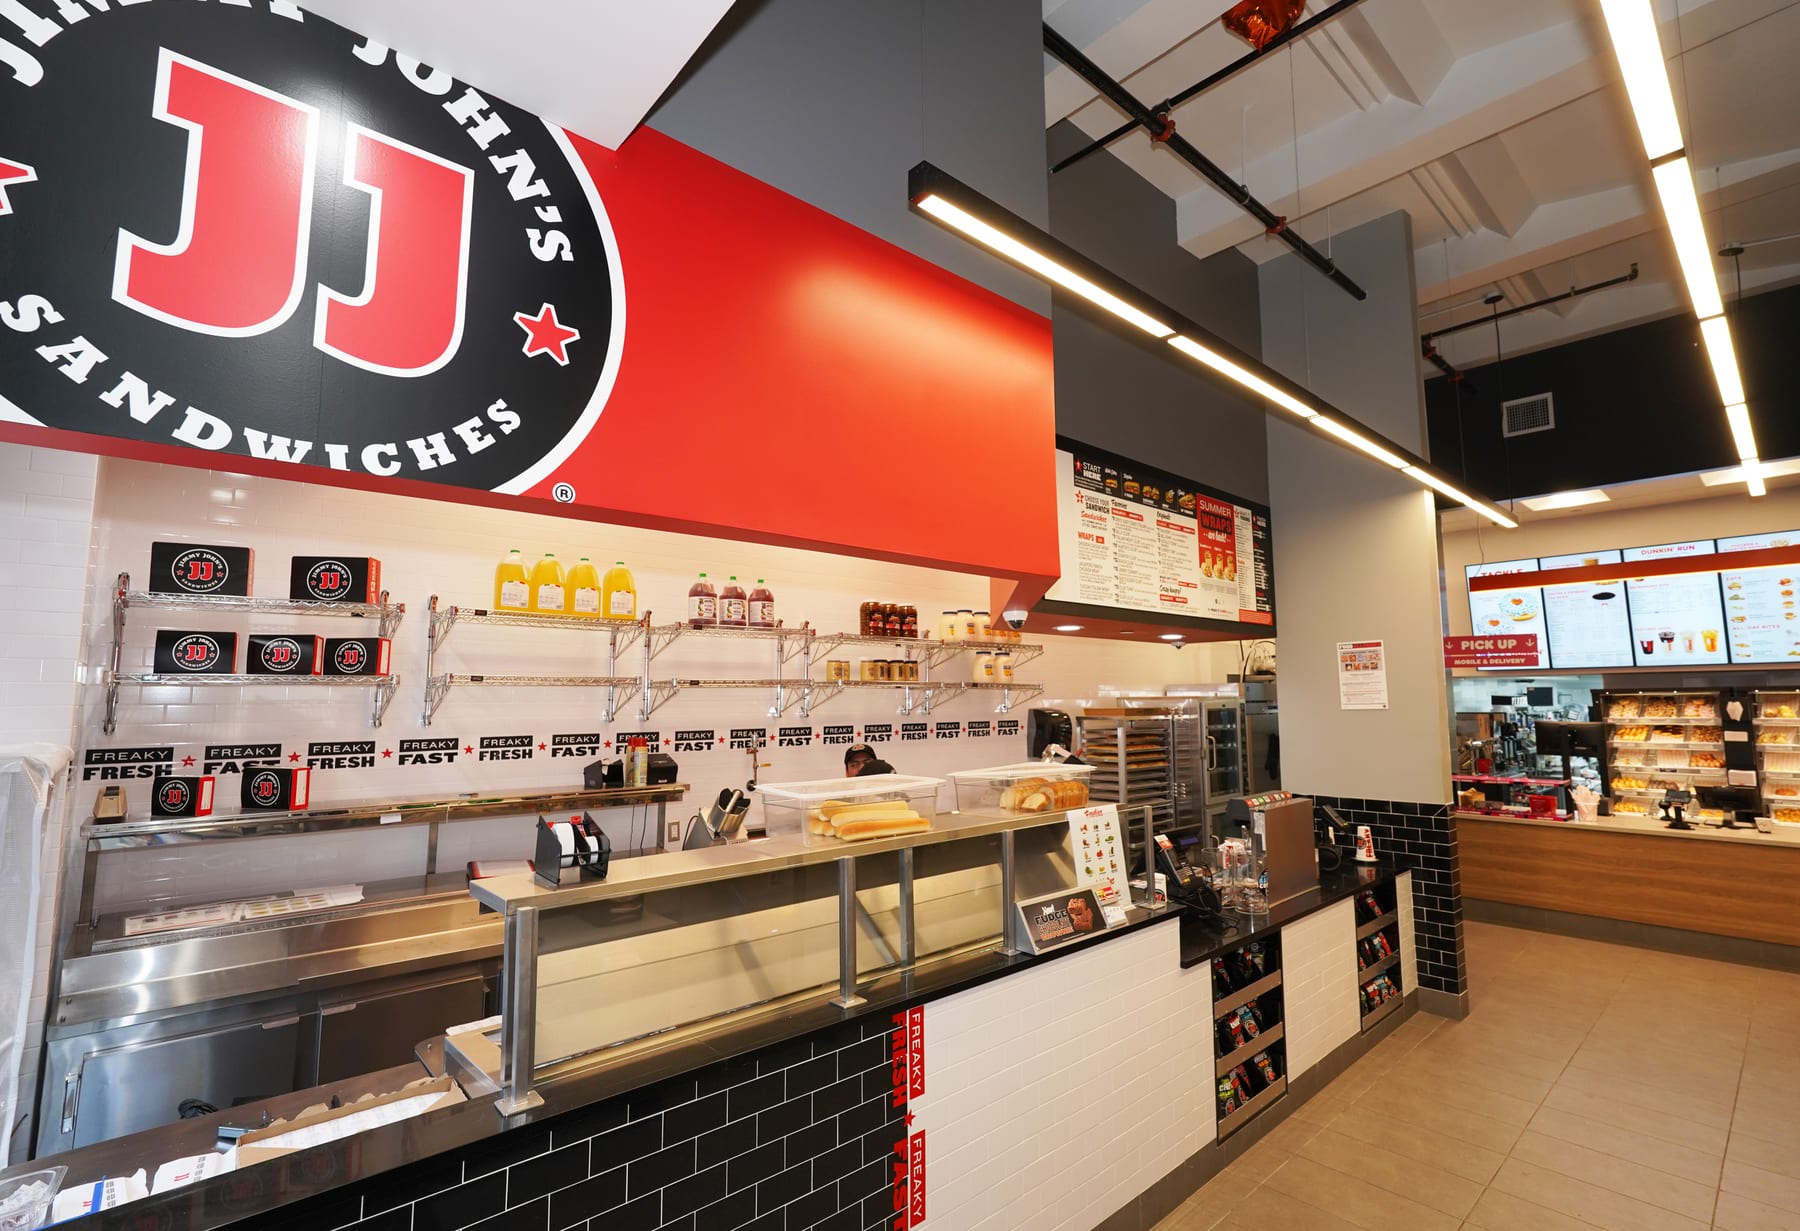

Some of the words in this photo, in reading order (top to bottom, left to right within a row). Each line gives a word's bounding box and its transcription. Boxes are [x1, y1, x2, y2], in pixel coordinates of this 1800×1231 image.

[111, 46, 475, 378] JJ
[0, 294, 521, 476] SANDWICHES
[1200, 500, 1232, 517] SUMMER
[1202, 511, 1232, 534] WRAPS
[188, 561, 213, 581] JJ
[319, 572, 340, 589] JJ
[1461, 640, 1494, 650] PICK
[1497, 639, 1517, 650] UP
[185, 644, 208, 661] JJ
[272, 647, 292, 662] JJ
[732, 728, 765, 738] FREAKY
[781, 728, 810, 736] FREAKY
[825, 726, 852, 735] FREAKY
[865, 725, 890, 734] FREAKY
[483, 737, 530, 747] FREAKY
[556, 734, 598, 746] FREAKY
[619, 732, 657, 742] FRKY
[778, 736, 812, 746] FAST
[823, 735, 854, 744] FRESH
[864, 733, 892, 742] FAST
[312, 744, 372, 754] FREAKY
[404, 738, 454, 750] FREAKY
[675, 742, 714, 752] FAST
[730, 739, 766, 750] FREH
[92, 750, 168, 762] FREAKY
[210, 747, 278, 758] FREAKY
[479, 748, 533, 761] FRESH
[551, 746, 599, 758] FAST
[307, 756, 374, 770] FRESH
[398, 752, 458, 766] FAST
[83, 764, 173, 781] FRESH
[1034, 910, 1068, 924] FUDGE
[912, 1012, 921, 1092] FREAKY
[892, 1010, 908, 1108] FRESH
[894, 1137, 908, 1231] FAST
[912, 1138, 922, 1218] FREAKY
